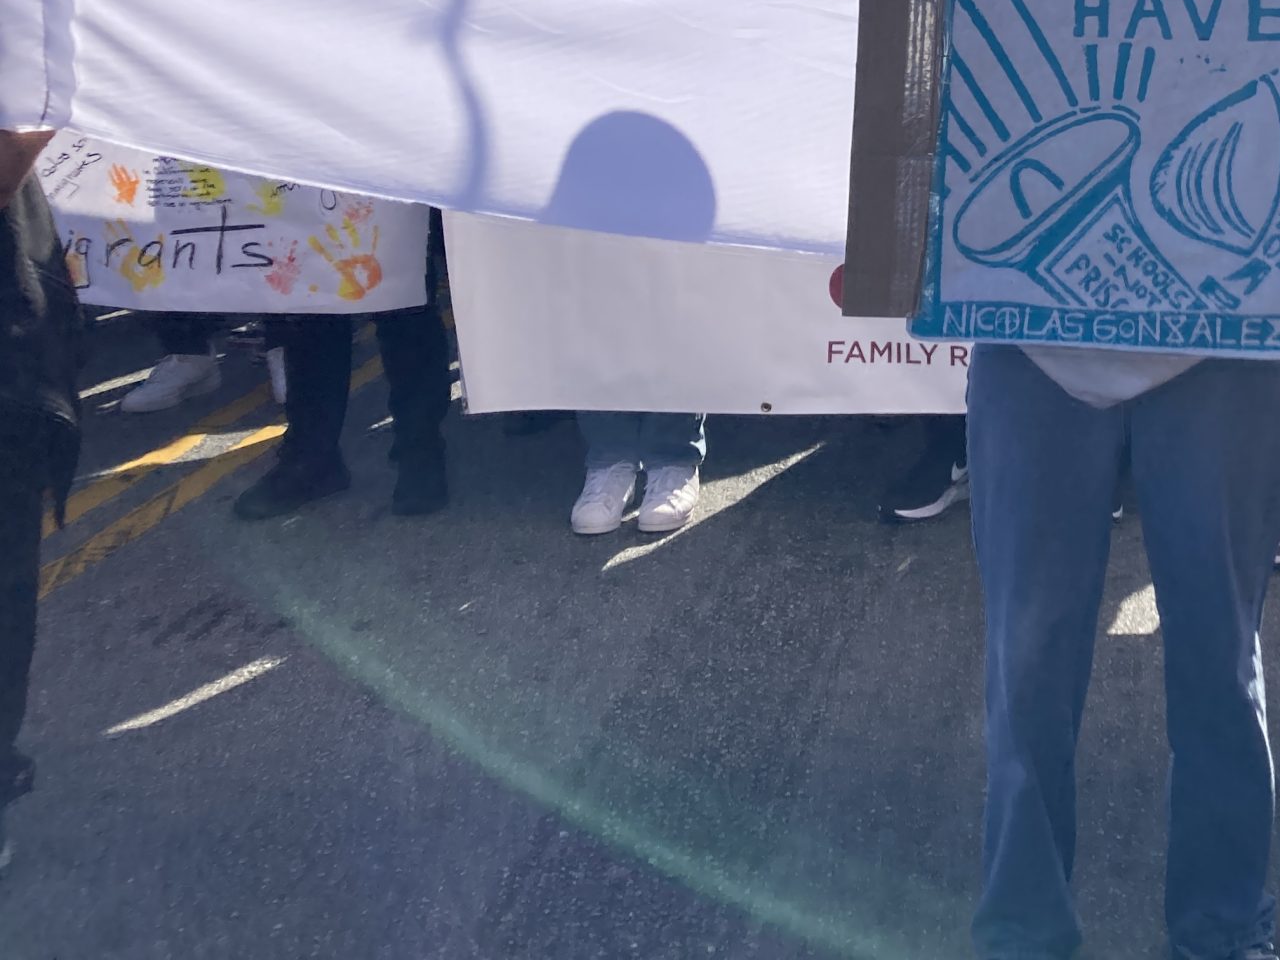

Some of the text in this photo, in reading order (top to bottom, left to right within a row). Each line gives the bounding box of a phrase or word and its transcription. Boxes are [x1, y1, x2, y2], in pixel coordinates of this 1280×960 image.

[1103, 223, 1190, 310] SCHOOLS
[942, 303, 1086, 341] NICOLAS
[826, 341, 938, 365] FAMILY
